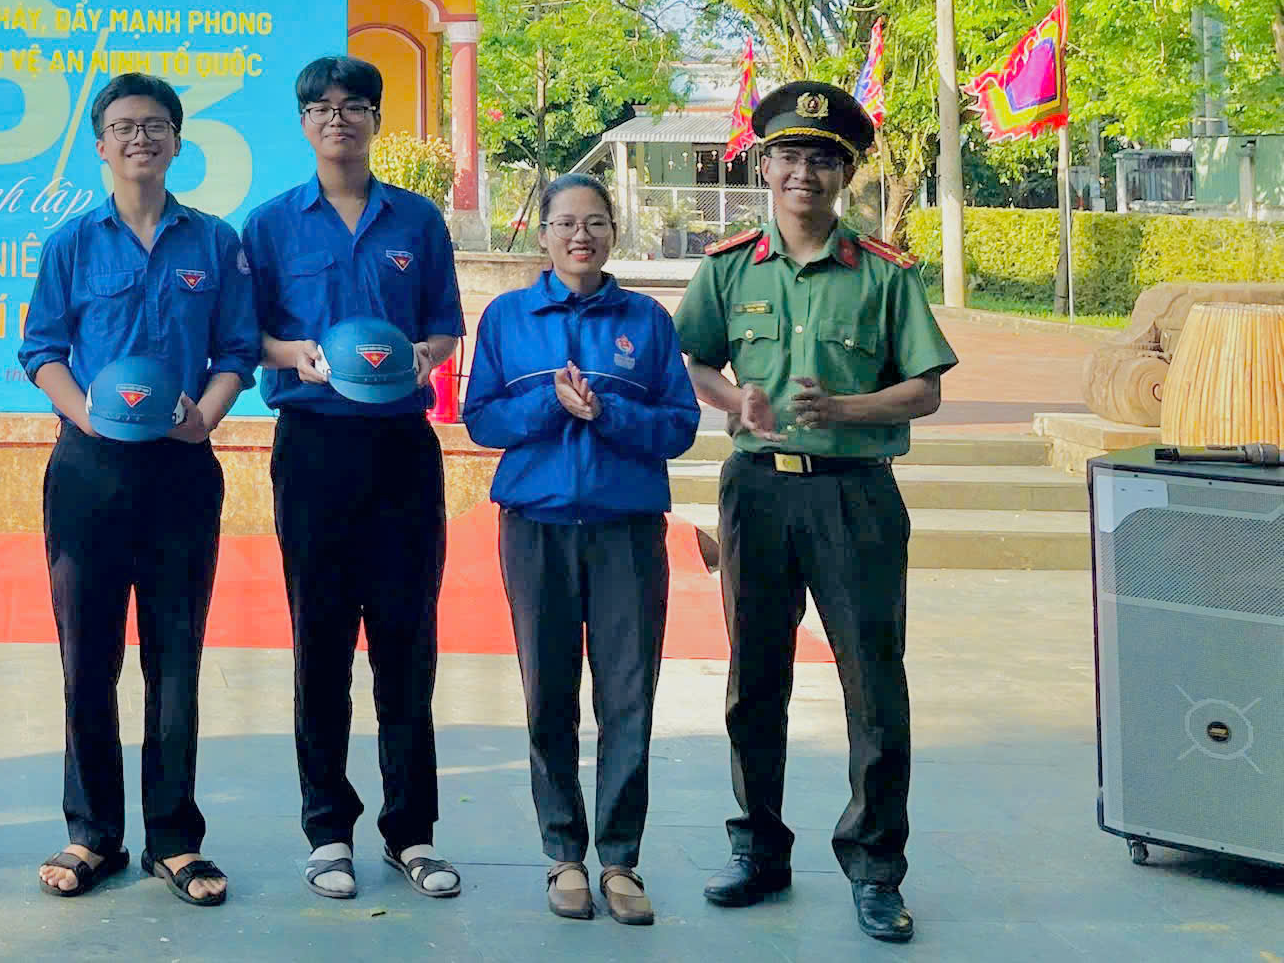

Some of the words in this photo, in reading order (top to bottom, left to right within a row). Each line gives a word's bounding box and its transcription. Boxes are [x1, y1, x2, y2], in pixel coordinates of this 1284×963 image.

[109, 8, 181, 40] MẠNH
[188, 10, 272, 35] PHONG
[11, 43, 42, 78] VỆ
[49, 49, 84, 74] AN
[92, 49, 151, 76] NINH
[156, 41, 191, 77] TỔ
[196, 44, 263, 80] QUỐC
[30, 176, 94, 230] lập
